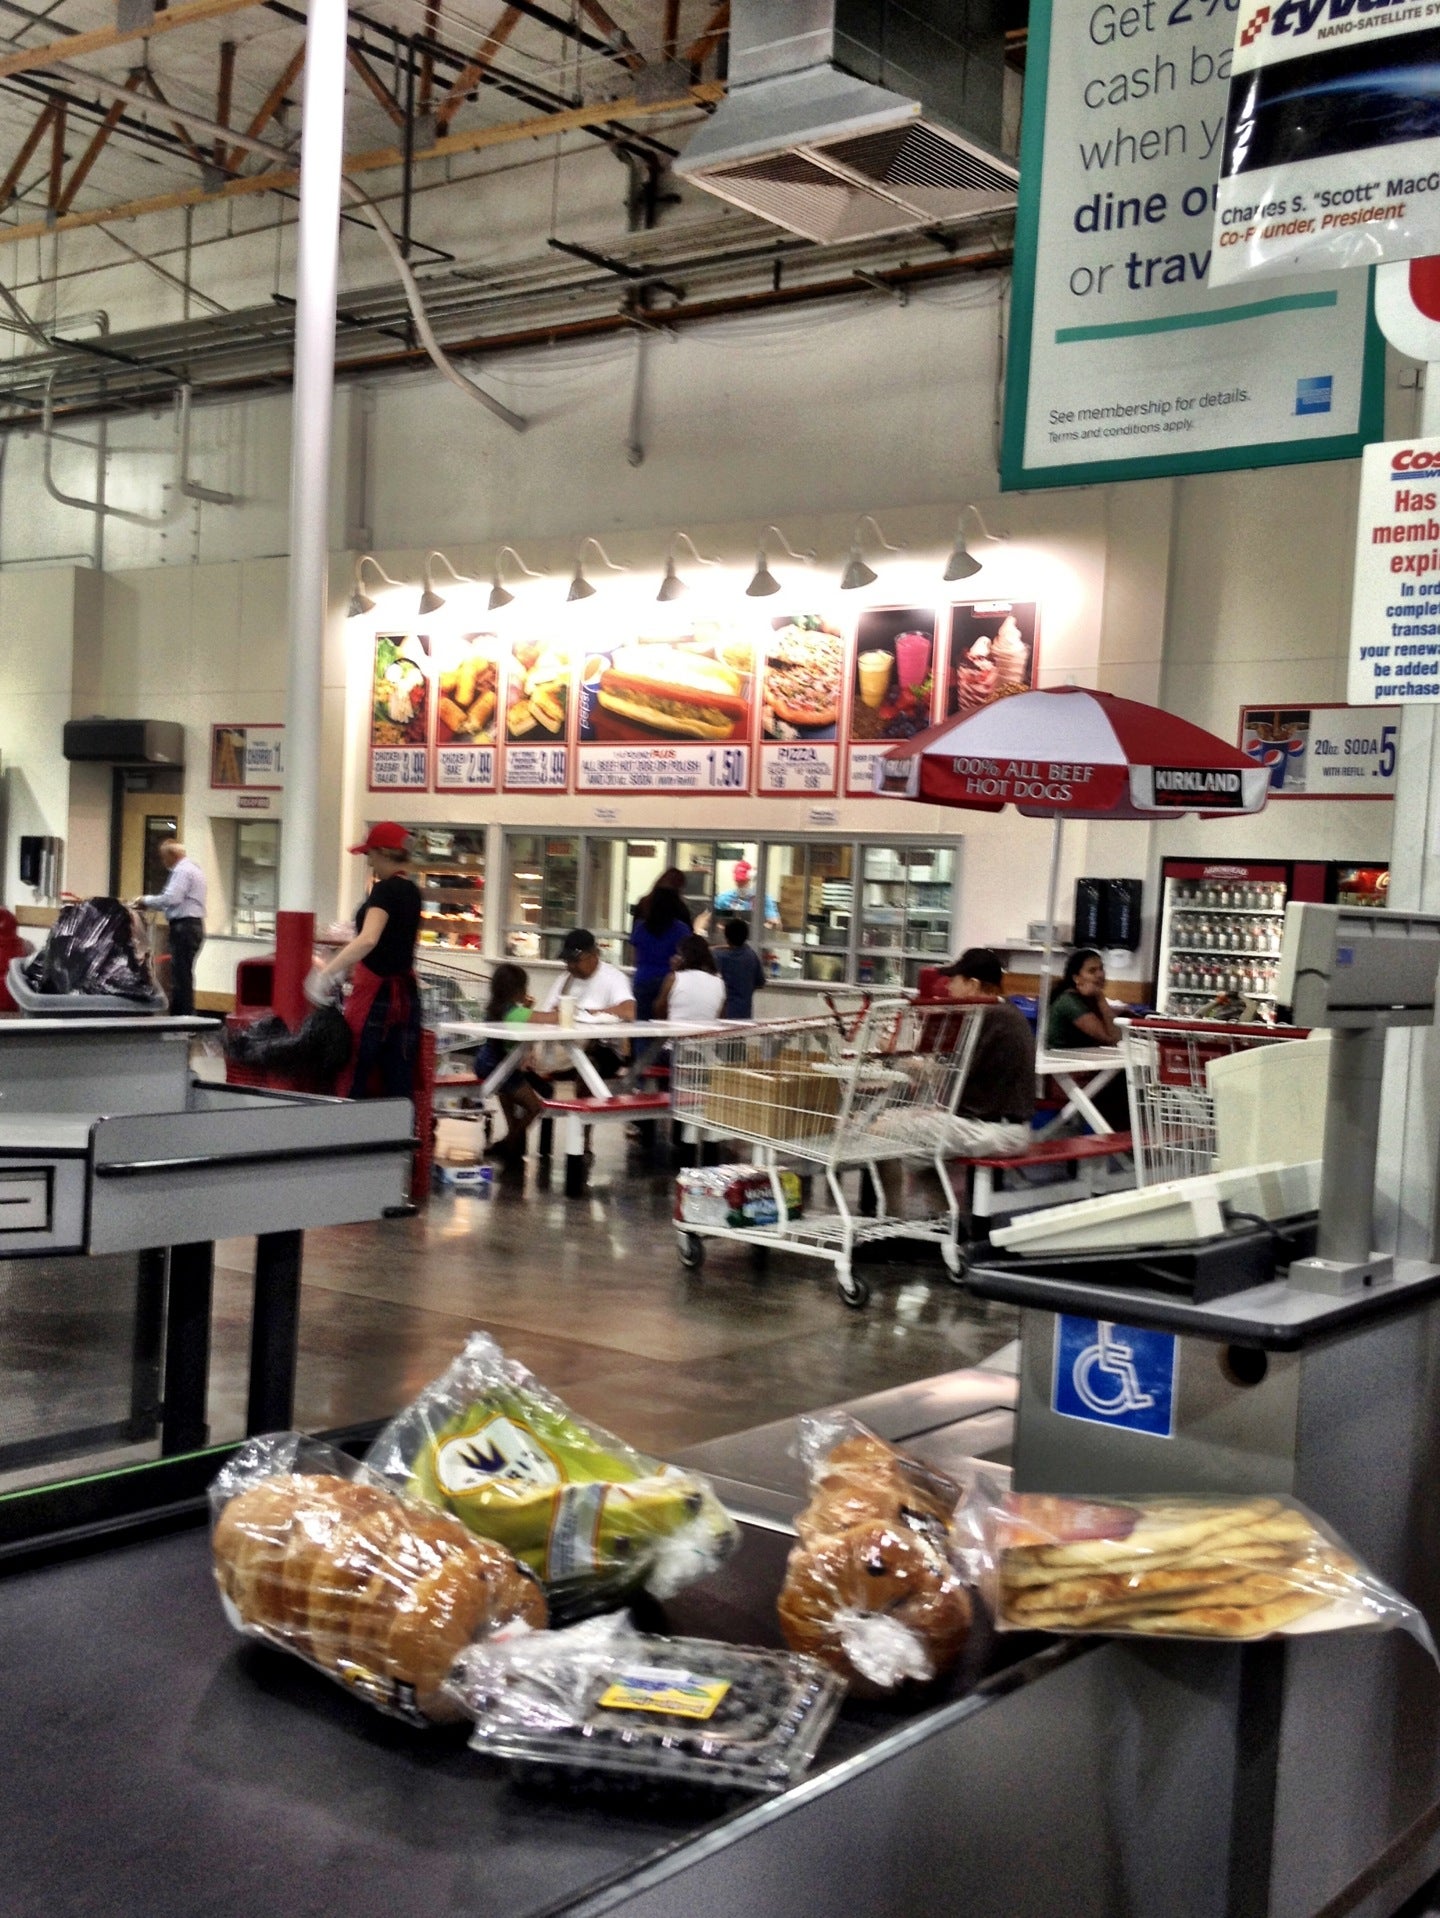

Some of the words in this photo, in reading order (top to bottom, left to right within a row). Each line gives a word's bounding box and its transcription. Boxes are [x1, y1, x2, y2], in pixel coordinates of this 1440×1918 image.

[1089, 0, 1155, 45] Get
[1317, 6, 1422, 40] NANO-SATELLITE
[1084, 54, 1175, 109] cash
[1079, 127, 1186, 171] when
[1073, 191, 1167, 233] dine
[1292, 196, 1308, 213] S.
[1218, 218, 1316, 248] Co-Funder,
[1320, 202, 1406, 230] President
[1069, 263, 1114, 297] or
[1049, 409, 1075, 425] See
[1077, 401, 1171, 421] membership
[1174, 396, 1194, 413] for
[1048, 430, 1079, 443] Terms
[1081, 428, 1101, 439] and
[1103, 422, 1160, 438] conditions
[1394, 489, 1437, 512] Has
[1372, 518, 1440, 544] memb
[1401, 583, 1414, 597] In
[1360, 646, 1390, 661] your
[1374, 662, 1391, 677] be
[1395, 660, 1439, 676] added
[778, 747, 818, 761] PIZZA
[1344, 738, 1378, 755] SODA
[952, 757, 1000, 777] 100%
[1003, 761, 1043, 780] ALL
[1048, 763, 1095, 783] BEEF
[1155, 770, 1240, 792] KIRKLAND
[1322, 766, 1341, 777] WITH
[1341, 766, 1366, 777] REFILL
[965, 777, 1011, 796] HOT
[1013, 780, 1073, 801] DOGS
